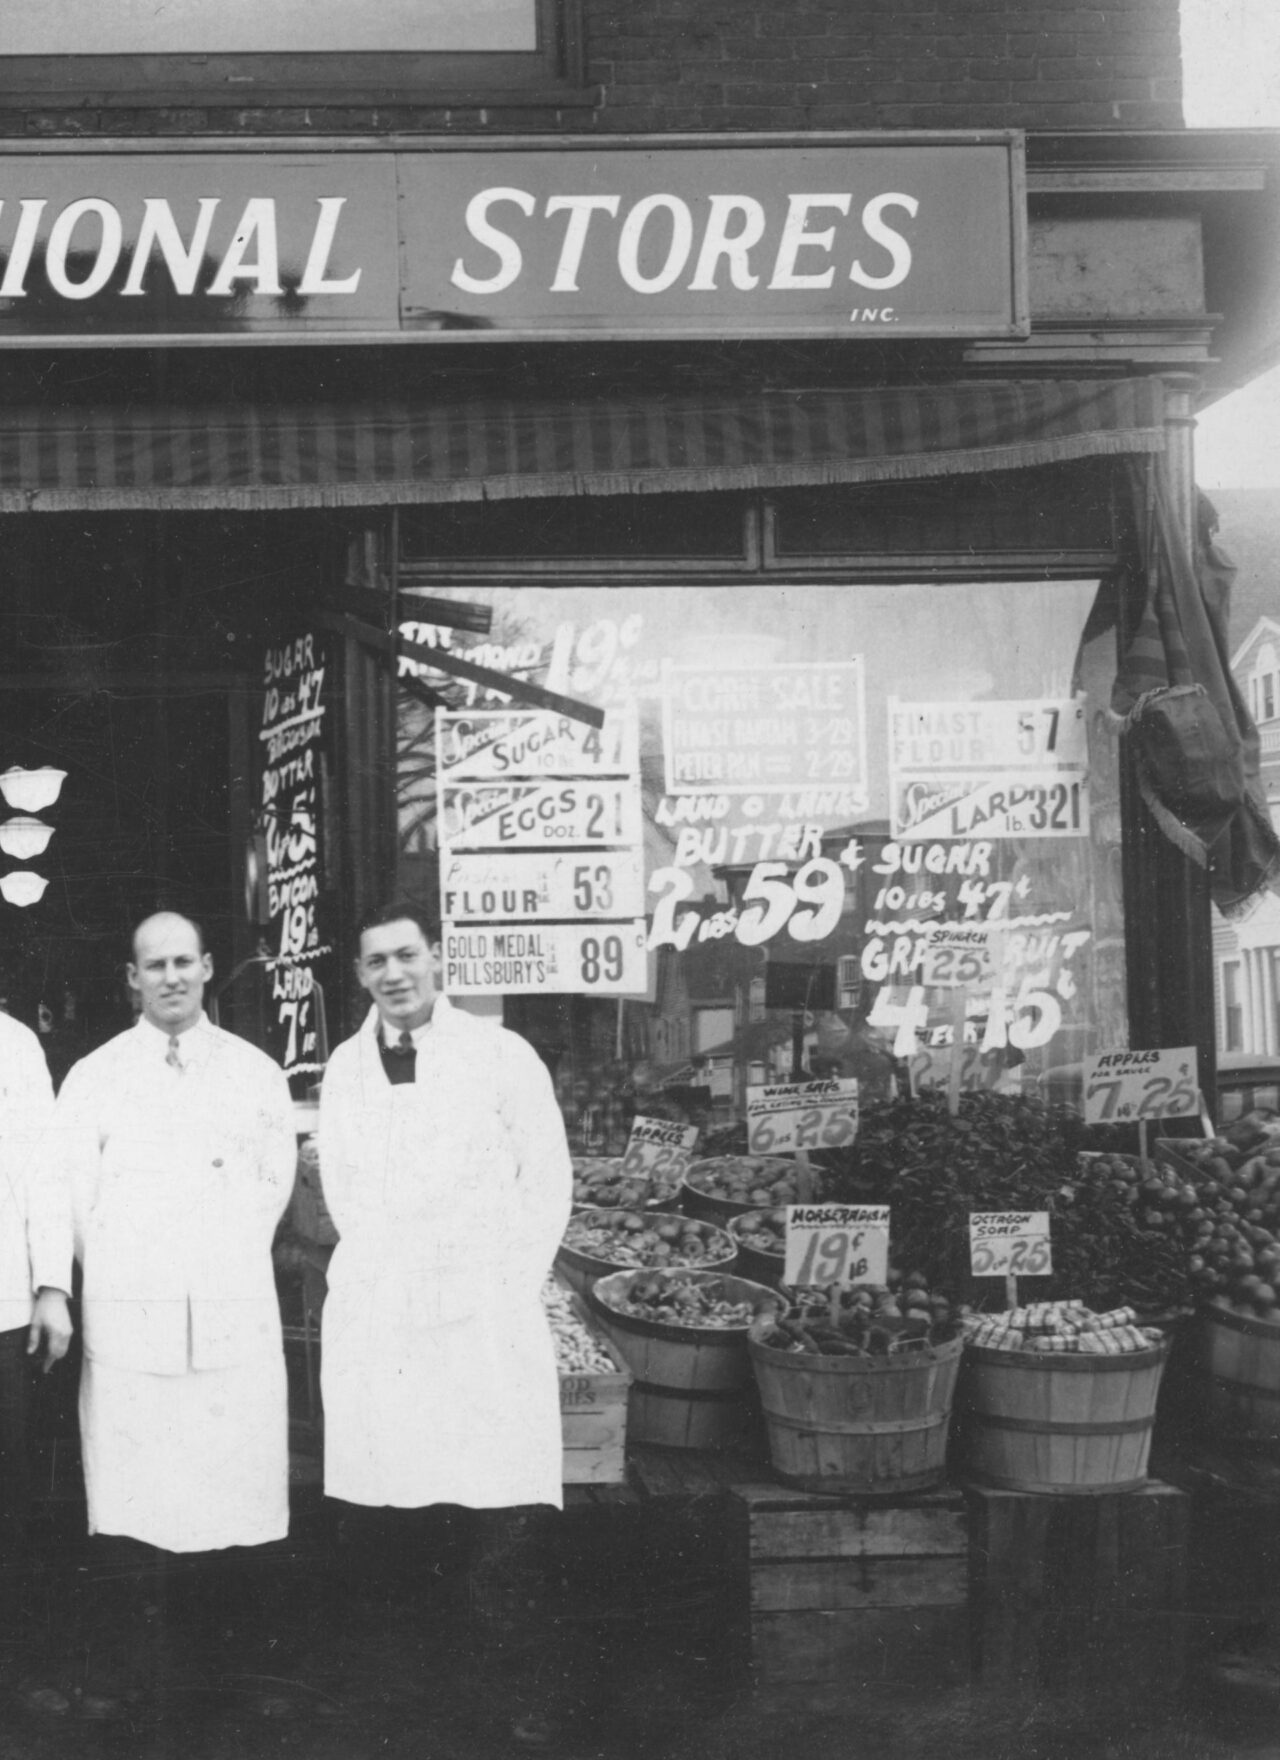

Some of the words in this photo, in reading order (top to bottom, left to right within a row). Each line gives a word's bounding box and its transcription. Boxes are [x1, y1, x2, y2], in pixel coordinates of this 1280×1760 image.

[450, 186, 920, 294] STORES
[772, 675, 844, 710] SALE
[893, 711, 982, 736] FINAST
[491, 718, 576, 772] SUGAR
[894, 738, 985, 763] FLOUR
[498, 788, 577, 841] EGGS
[654, 794, 731, 827] LAND
[778, 791, 869, 820] LAKES
[950, 782, 1028, 836] LARD
[673, 822, 825, 868] BUTTER
[871, 841, 993, 877] SUGAR
[445, 888, 539, 915] FLOUR
[572, 864, 614, 912] 53
[647, 866, 701, 952] 2
[447, 934, 488, 960] GOLD
[492, 933, 546, 959] MEDAL
[930, 930, 989, 945] SPINACH
[447, 959, 547, 986] PILLSBURY'S
[579, 934, 625, 985] 89
[273, 966, 313, 1000] LARD
[1098, 1051, 1161, 1068] APPLES
[631, 1125, 685, 1146] APPLES
[790, 1207, 889, 1224] HORSERADISH
[971, 1214, 1031, 1226] OCTAGON
[977, 1225, 1022, 1236] SOAP
